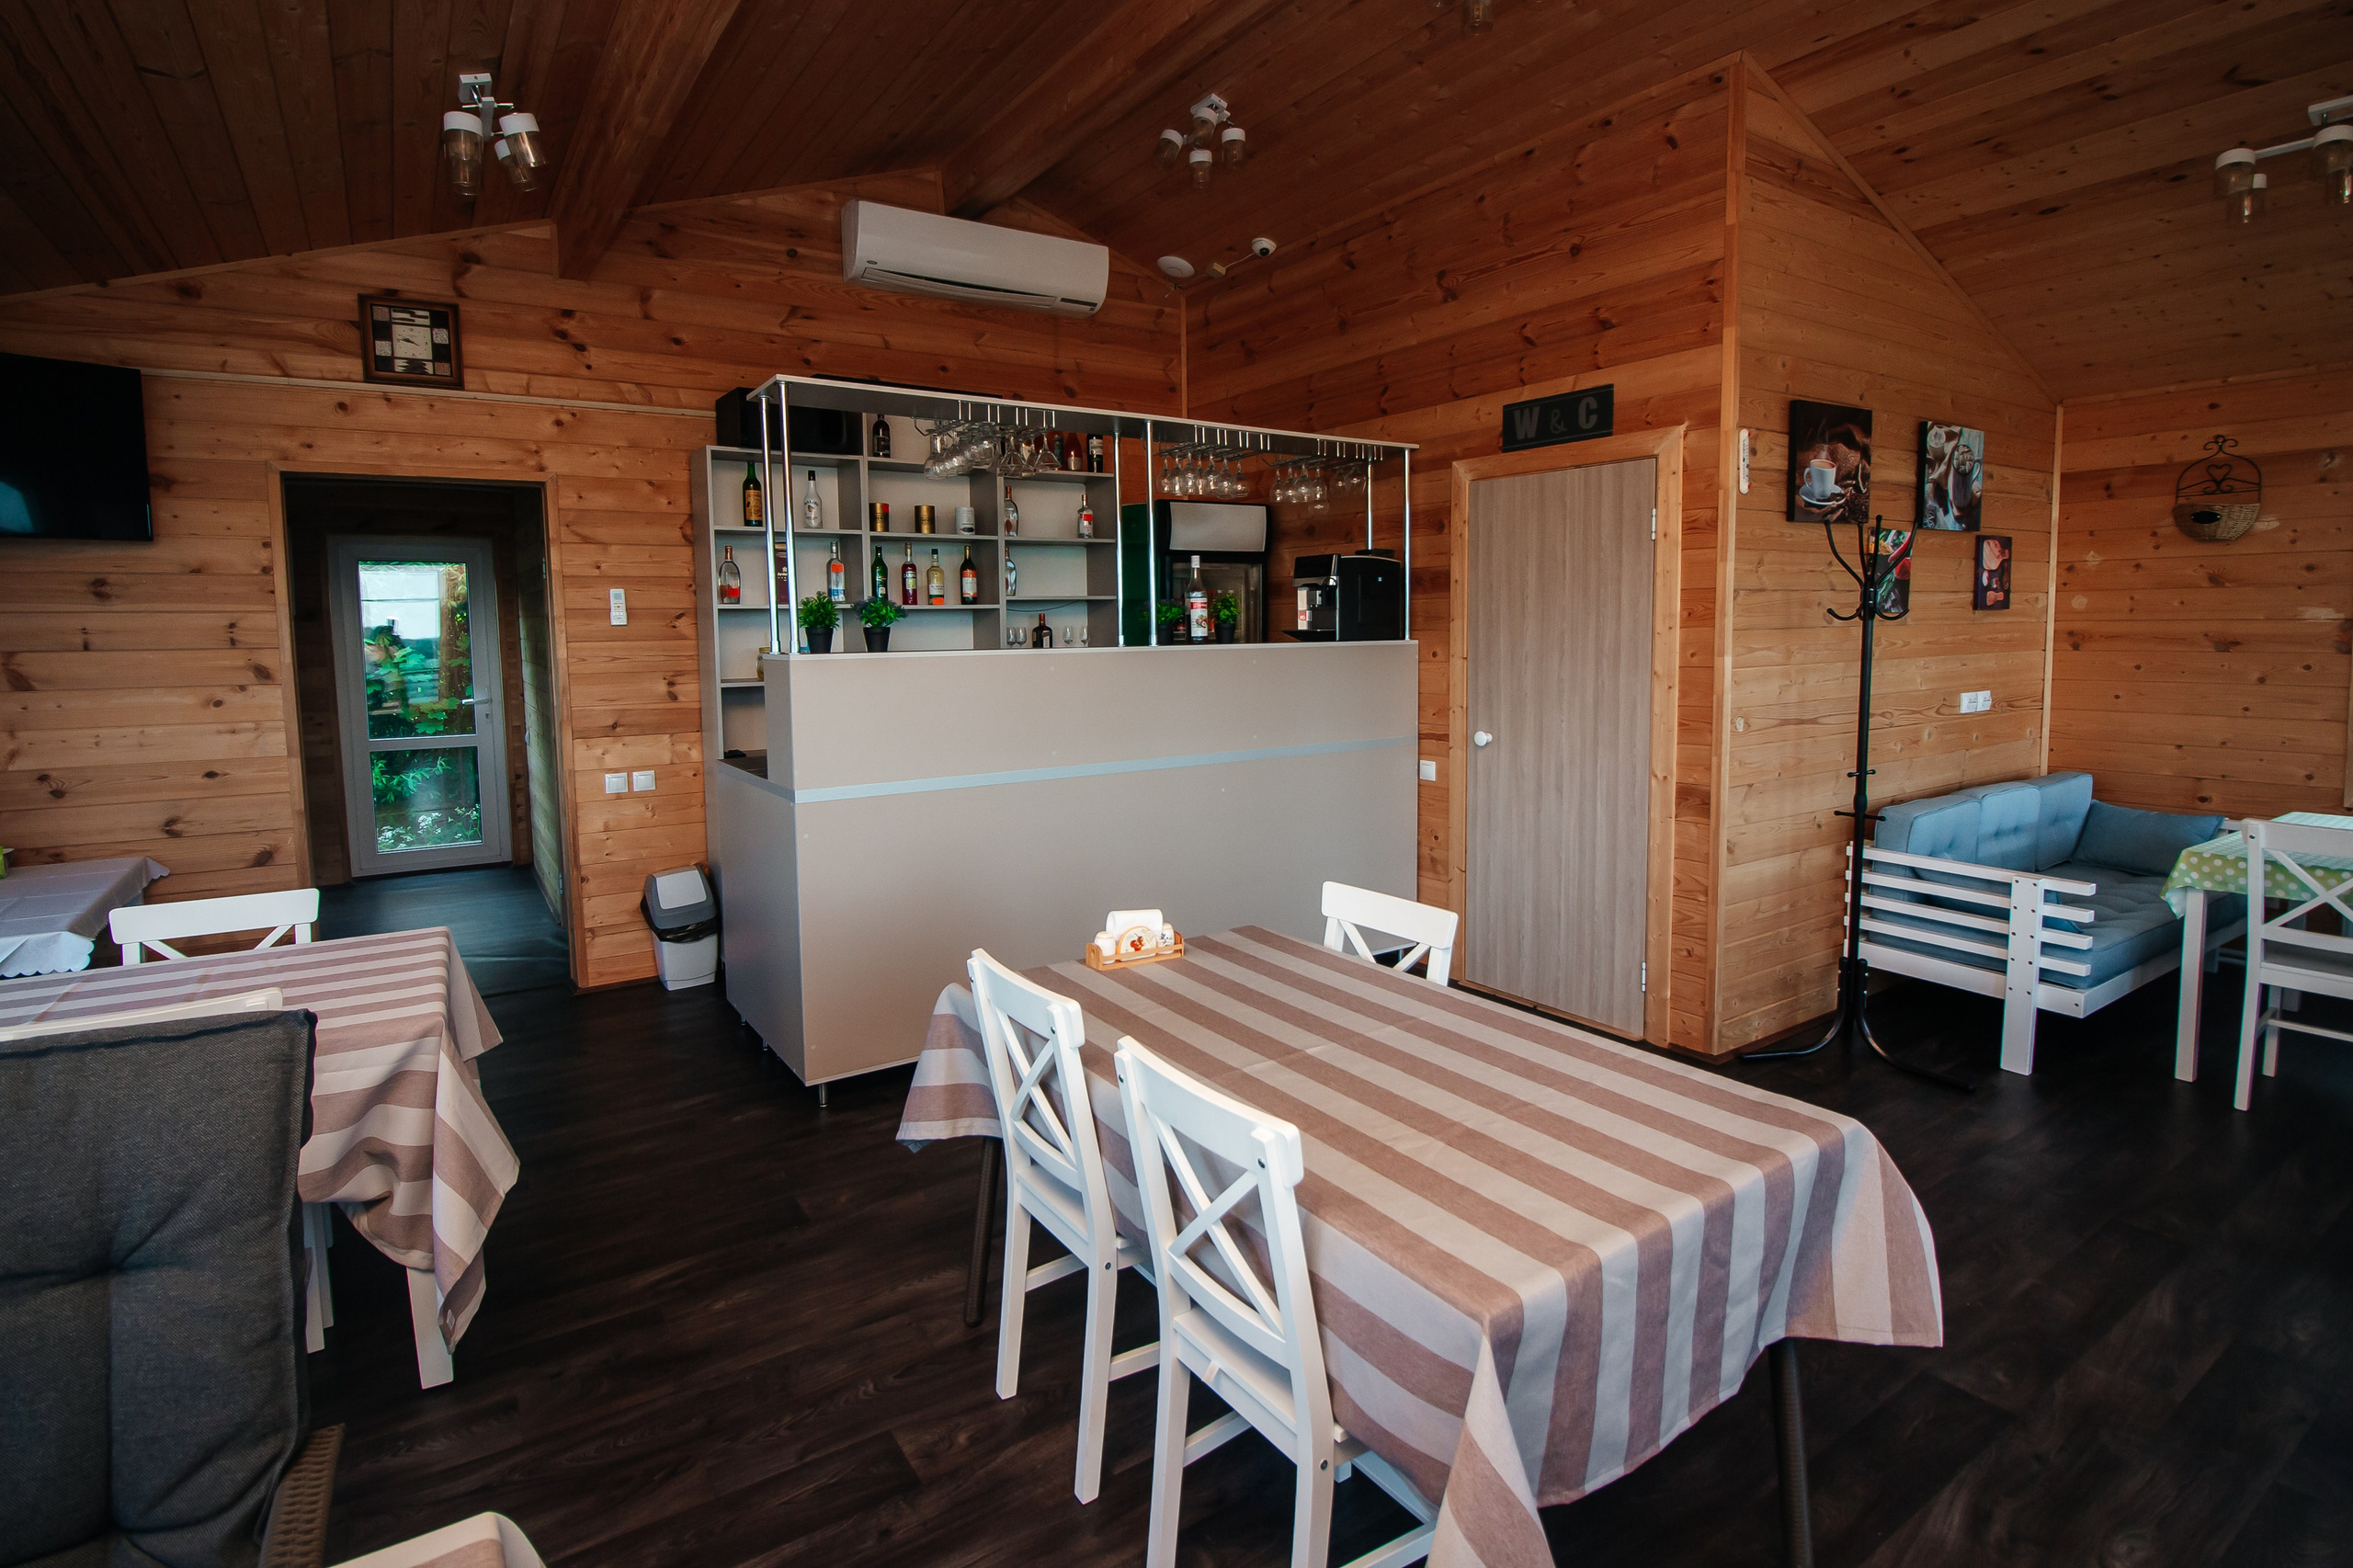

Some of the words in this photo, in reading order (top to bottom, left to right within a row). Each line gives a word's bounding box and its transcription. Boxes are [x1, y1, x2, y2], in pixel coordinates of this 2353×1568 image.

[1513, 405, 1540, 440] W
[1550, 408, 1567, 435] &
[1577, 396, 1598, 430] C
